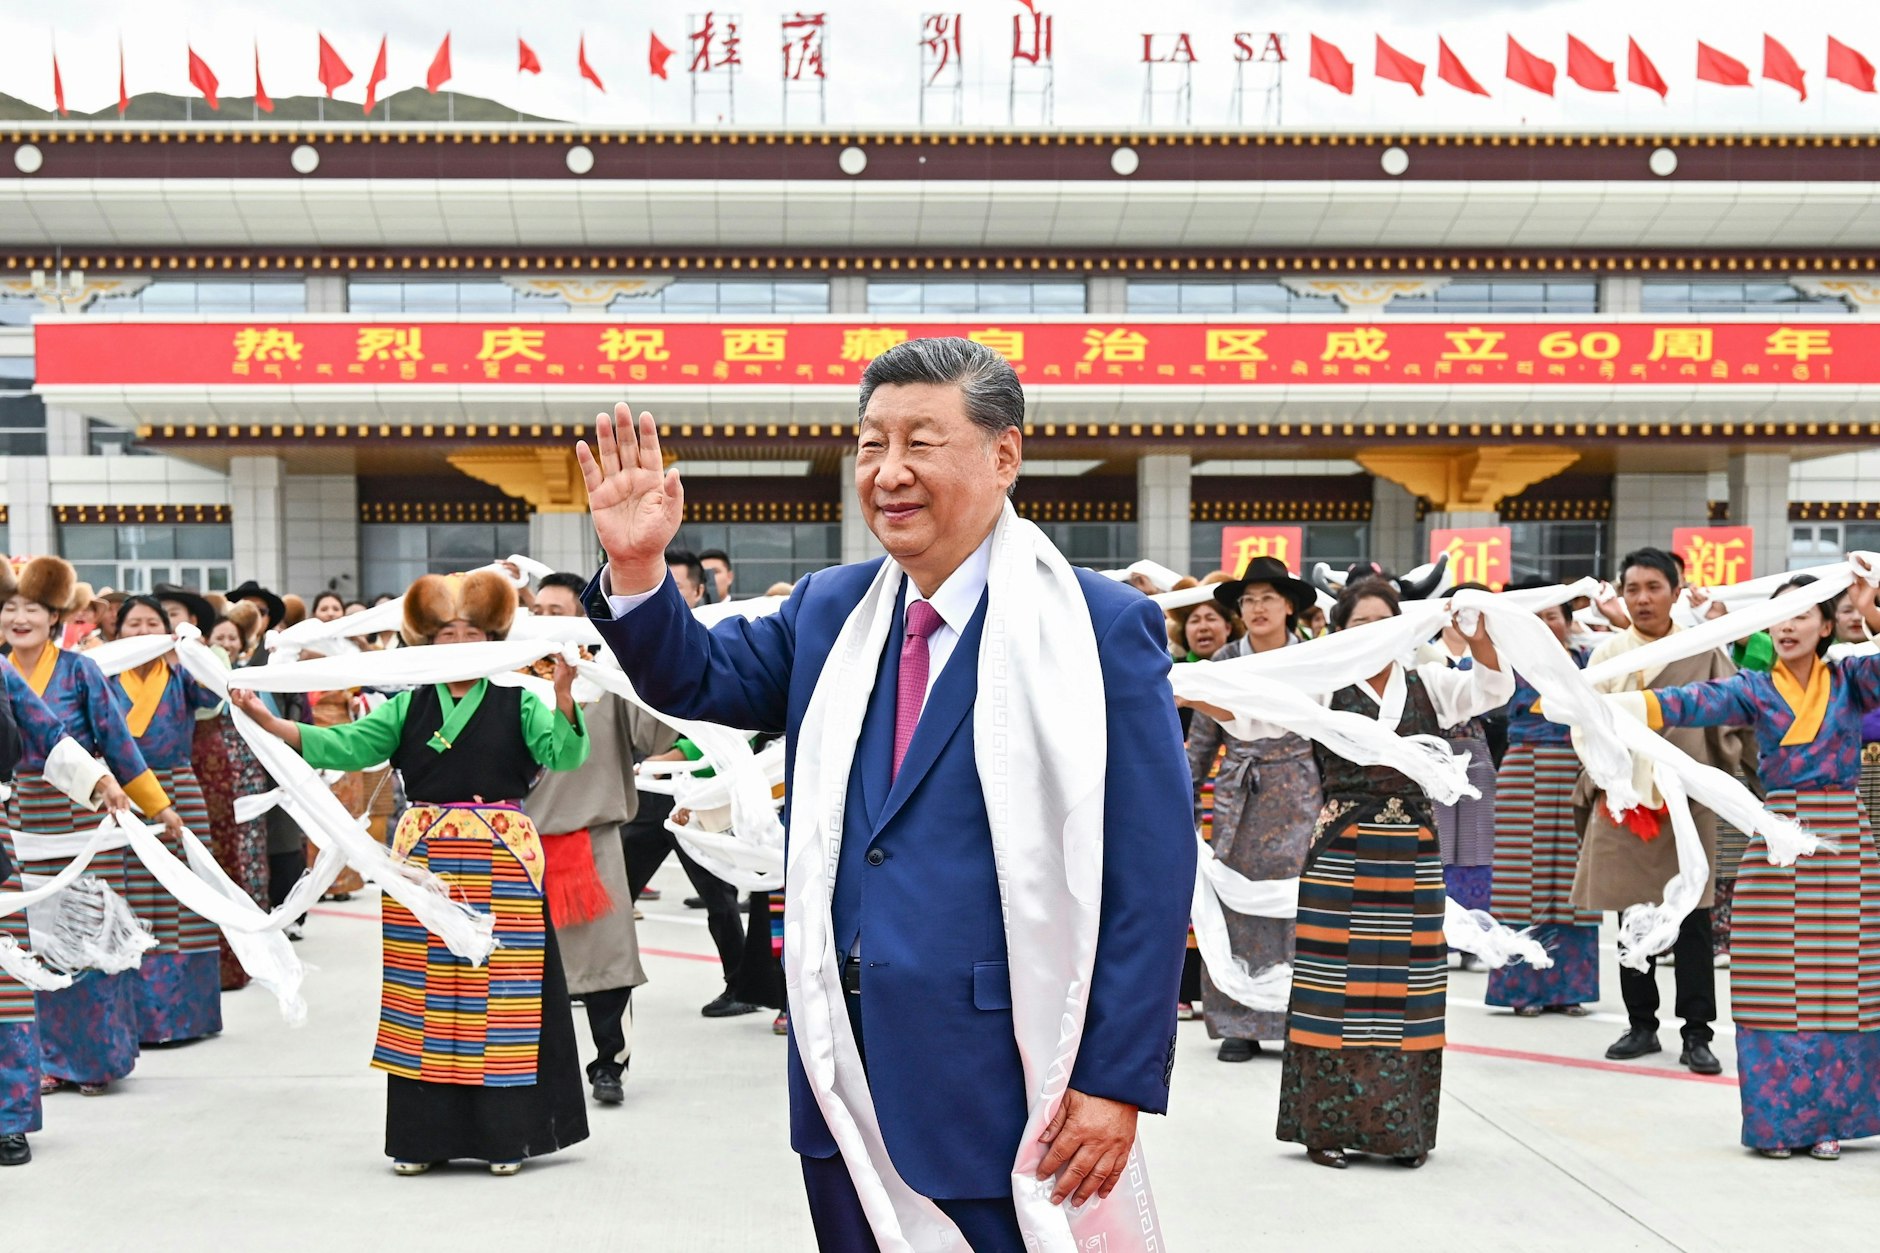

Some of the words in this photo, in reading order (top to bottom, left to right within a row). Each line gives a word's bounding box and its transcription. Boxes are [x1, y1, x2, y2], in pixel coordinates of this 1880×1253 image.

[1141, 33, 1198, 62] LA
[1234, 32, 1287, 62] SA
[1683, 534, 1746, 587] 新
